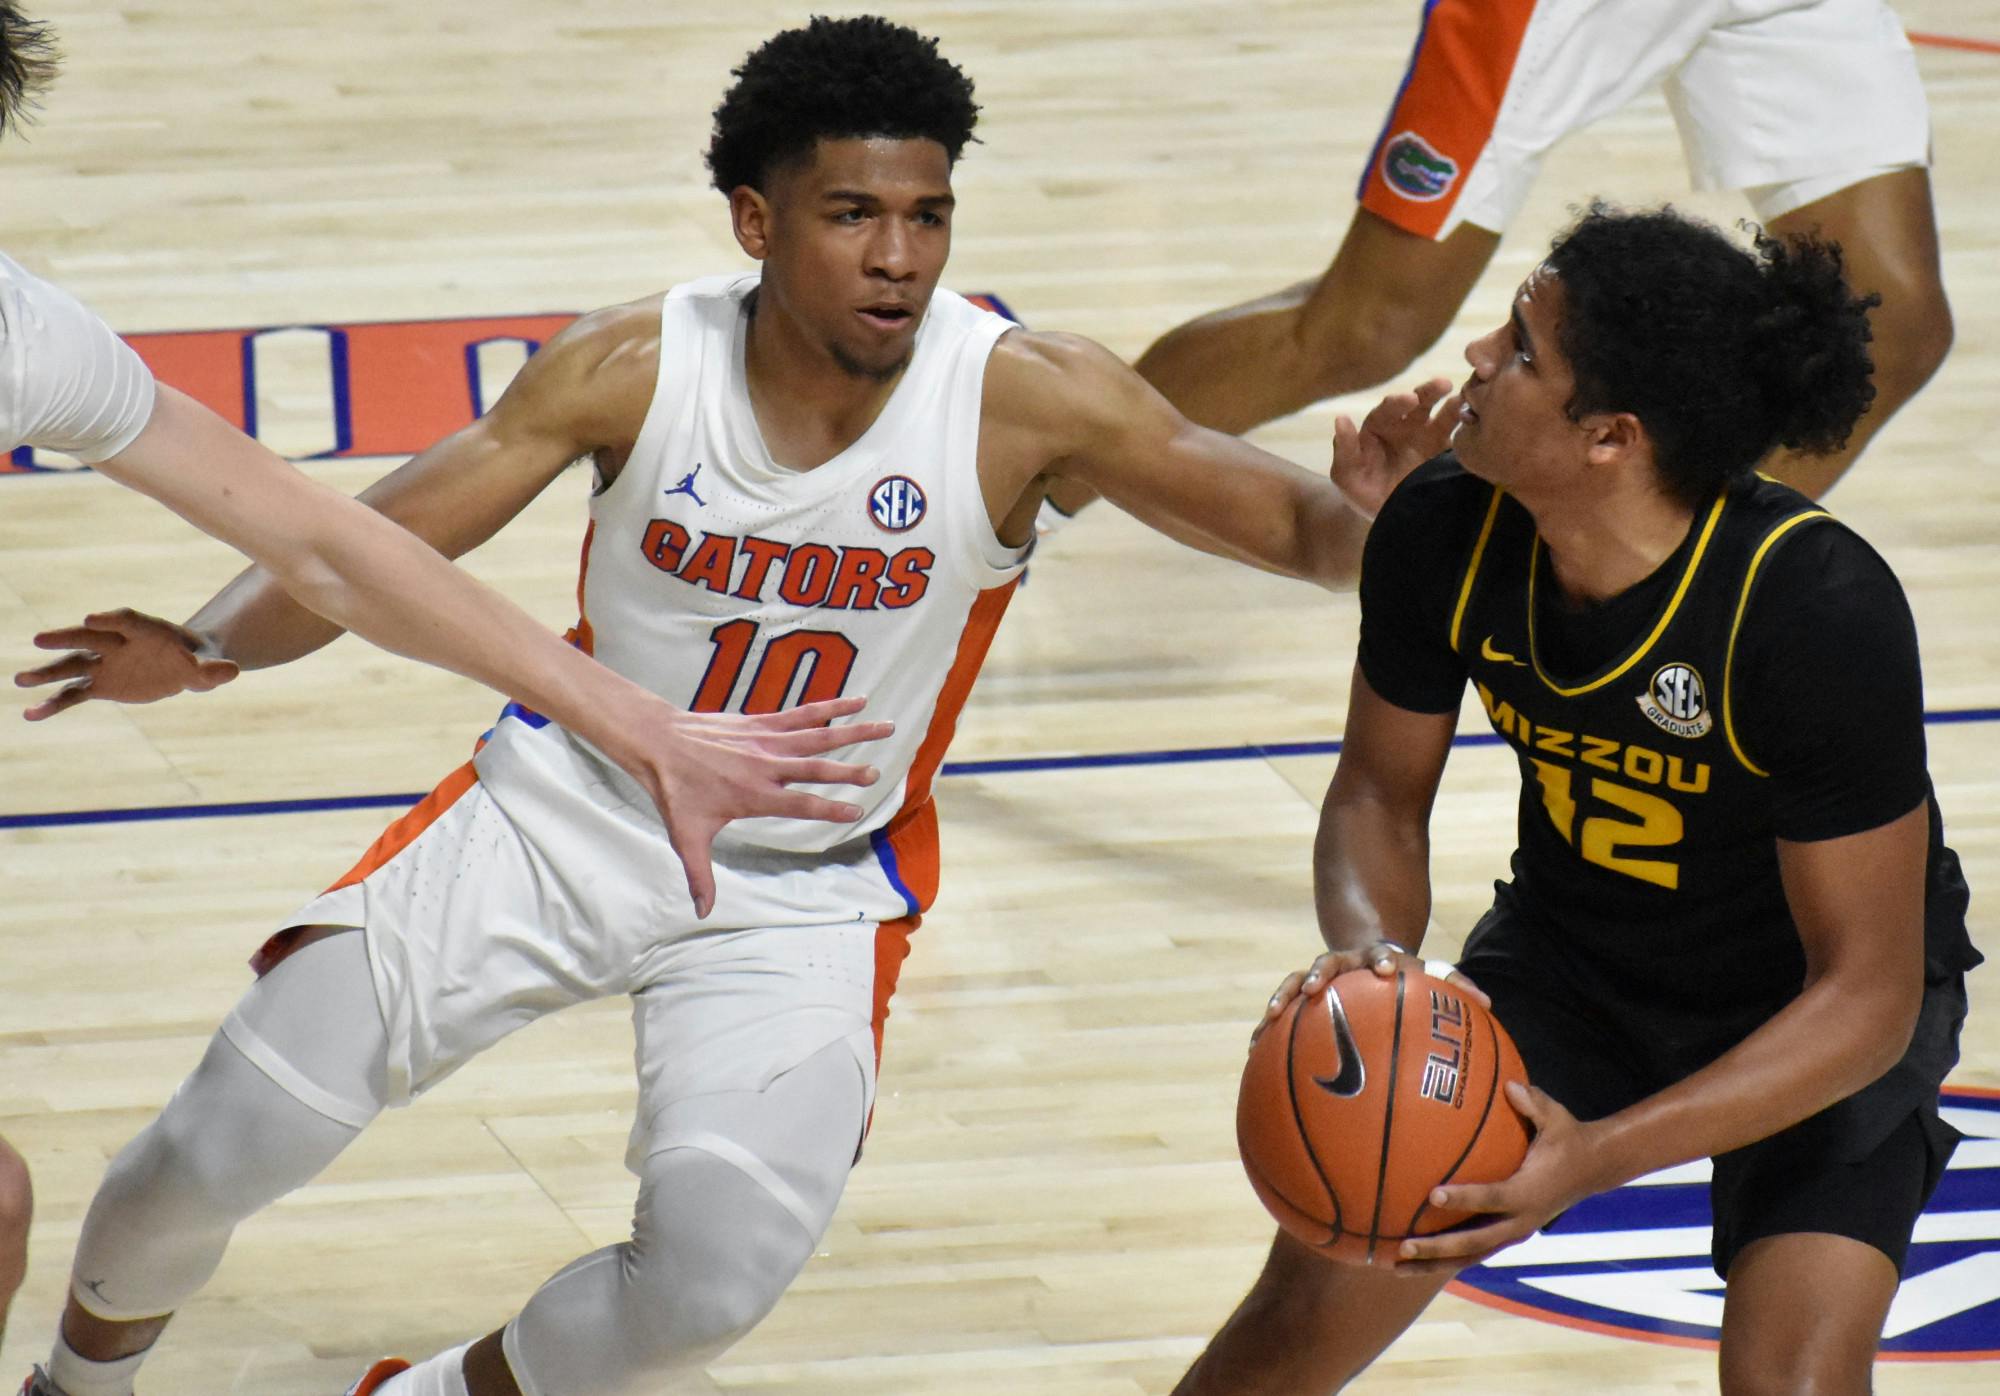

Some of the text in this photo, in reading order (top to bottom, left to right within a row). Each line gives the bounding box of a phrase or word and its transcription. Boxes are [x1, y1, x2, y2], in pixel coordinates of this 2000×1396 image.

[873, 480, 922, 528] SEC
[640, 518, 936, 611] GATORS
[688, 618, 858, 727] 10
[1646, 705, 1705, 737] GRADUATE
[1656, 667, 1702, 719] SEC
[1477, 681, 1711, 794] MIZZOU
[1528, 757, 1684, 890] 12
[1421, 990, 1462, 1105] ELITE
